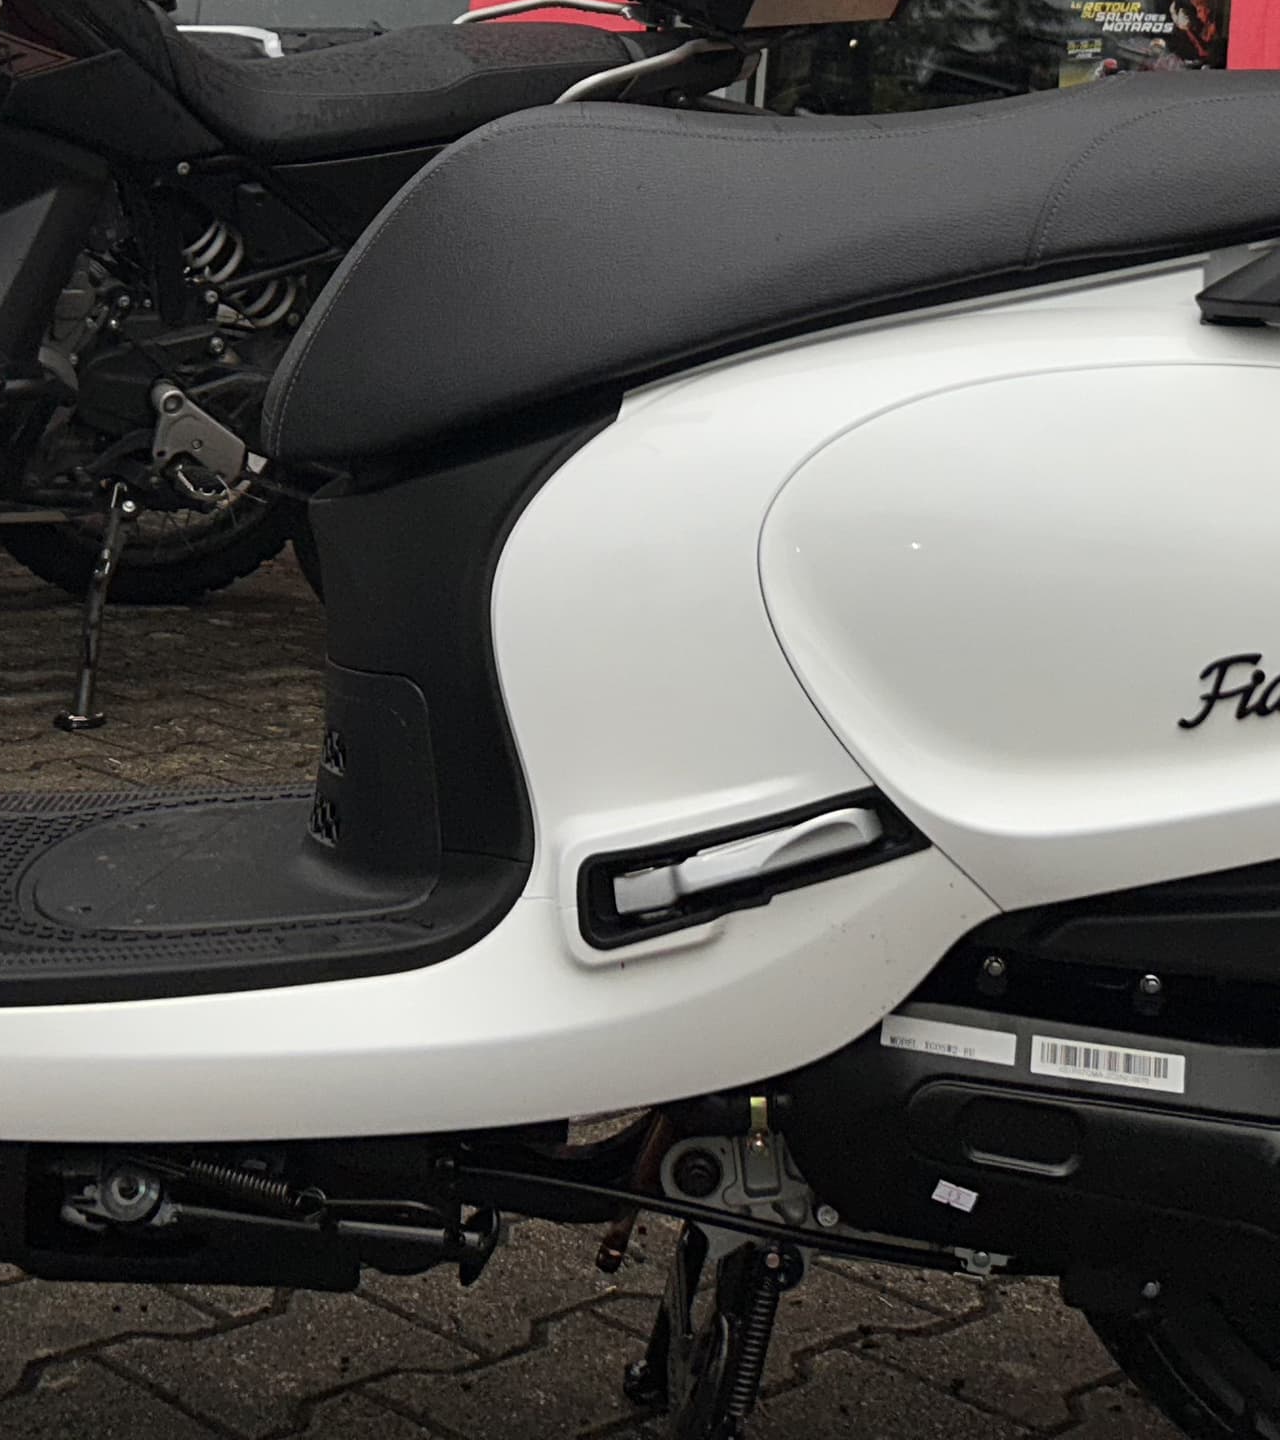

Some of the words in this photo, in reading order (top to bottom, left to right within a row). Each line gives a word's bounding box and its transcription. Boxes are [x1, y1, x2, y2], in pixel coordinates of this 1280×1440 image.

[1082, 1, 1142, 13] RETOUR
[1095, 11, 1144, 22] SALON
[1144, 13, 1166, 22] DES
[1102, 22, 1174, 33] MOTARDS
